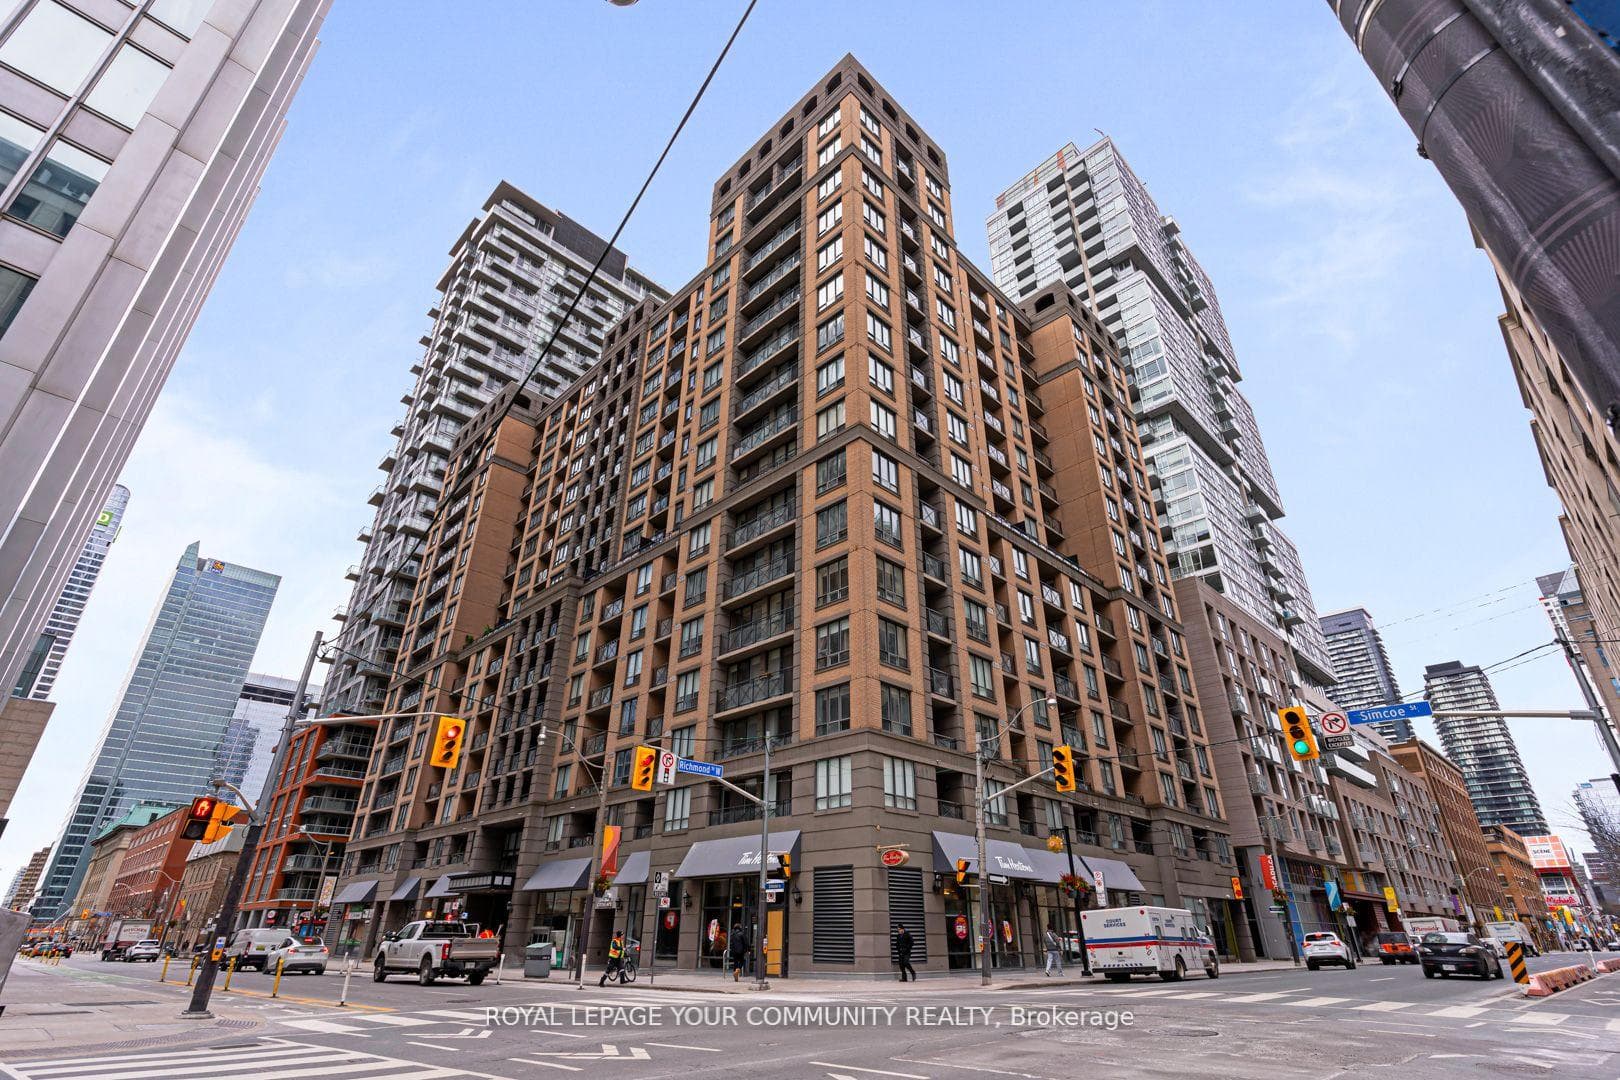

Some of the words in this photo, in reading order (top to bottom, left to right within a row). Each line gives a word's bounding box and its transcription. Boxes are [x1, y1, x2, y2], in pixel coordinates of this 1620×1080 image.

[1360, 708, 1406, 721] Simcoe
[1409, 704, 1417, 712] St
[679, 760, 710, 774] Richmond
[715, 767, 722, 776] W
[738, 851, 753, 865] Tim
[994, 856, 1010, 869] Tim
[1007, 857, 1034, 872] Hortons
